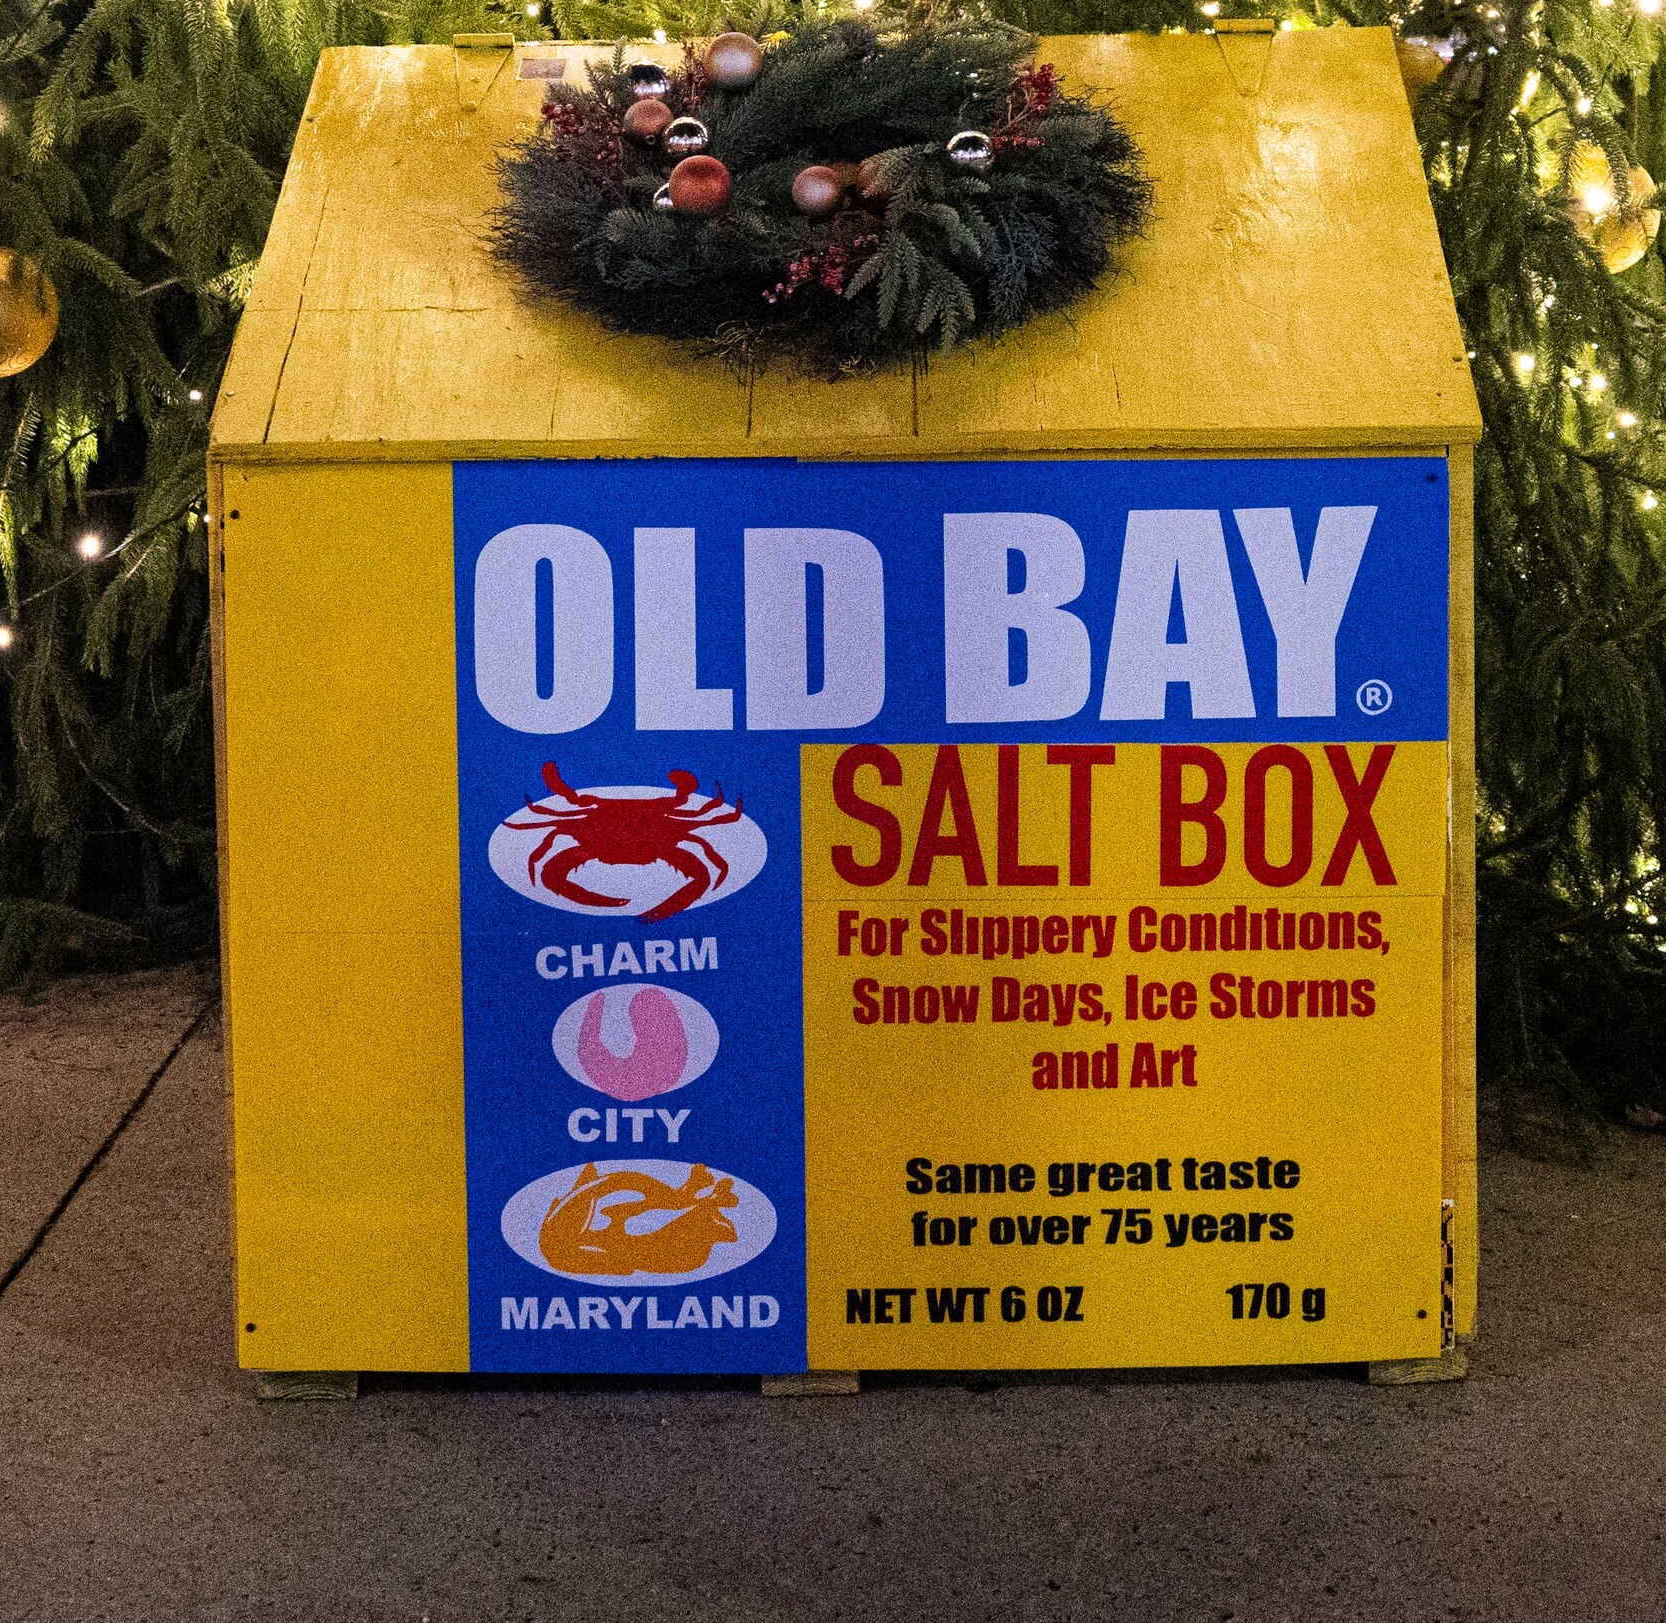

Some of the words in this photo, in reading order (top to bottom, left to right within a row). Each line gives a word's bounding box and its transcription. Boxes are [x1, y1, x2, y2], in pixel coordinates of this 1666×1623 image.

[474, 523, 885, 734] OLD
[943, 505, 1379, 724] BAY
[830, 744, 1116, 888] SALT
[1159, 744, 1397, 888] BOX
[837, 909, 909, 957] For
[919, 907, 1116, 961] Slippery
[1128, 905, 1390, 956] Conditions,
[536, 937, 719, 979] CHARM
[852, 977, 980, 1026] Snow
[991, 976, 1112, 1030] Days,
[1125, 974, 1197, 1021] Ice
[1209, 972, 1376, 1020] Storms
[1031, 1042, 1119, 1090] and
[1129, 1042, 1197, 1089] Art
[567, 1107, 691, 1144] CITY
[905, 1157, 1036, 1195] Same
[1047, 1158, 1171, 1197] great
[1182, 1156, 1300, 1191] taste
[911, 1210, 978, 1246] for
[988, 1215, 1091, 1246] over
[1101, 1208, 1153, 1245] 75
[1164, 1212, 1294, 1248] years
[500, 1294, 780, 1331] MARYLAND
[846, 1287, 917, 1325] NET
[925, 1287, 991, 1324] WT
[1000, 1285, 1027, 1323] 6
[1036, 1285, 1084, 1323] OZ
[1227, 1282, 1291, 1320] 170
[1301, 1288, 1326, 1324] g
